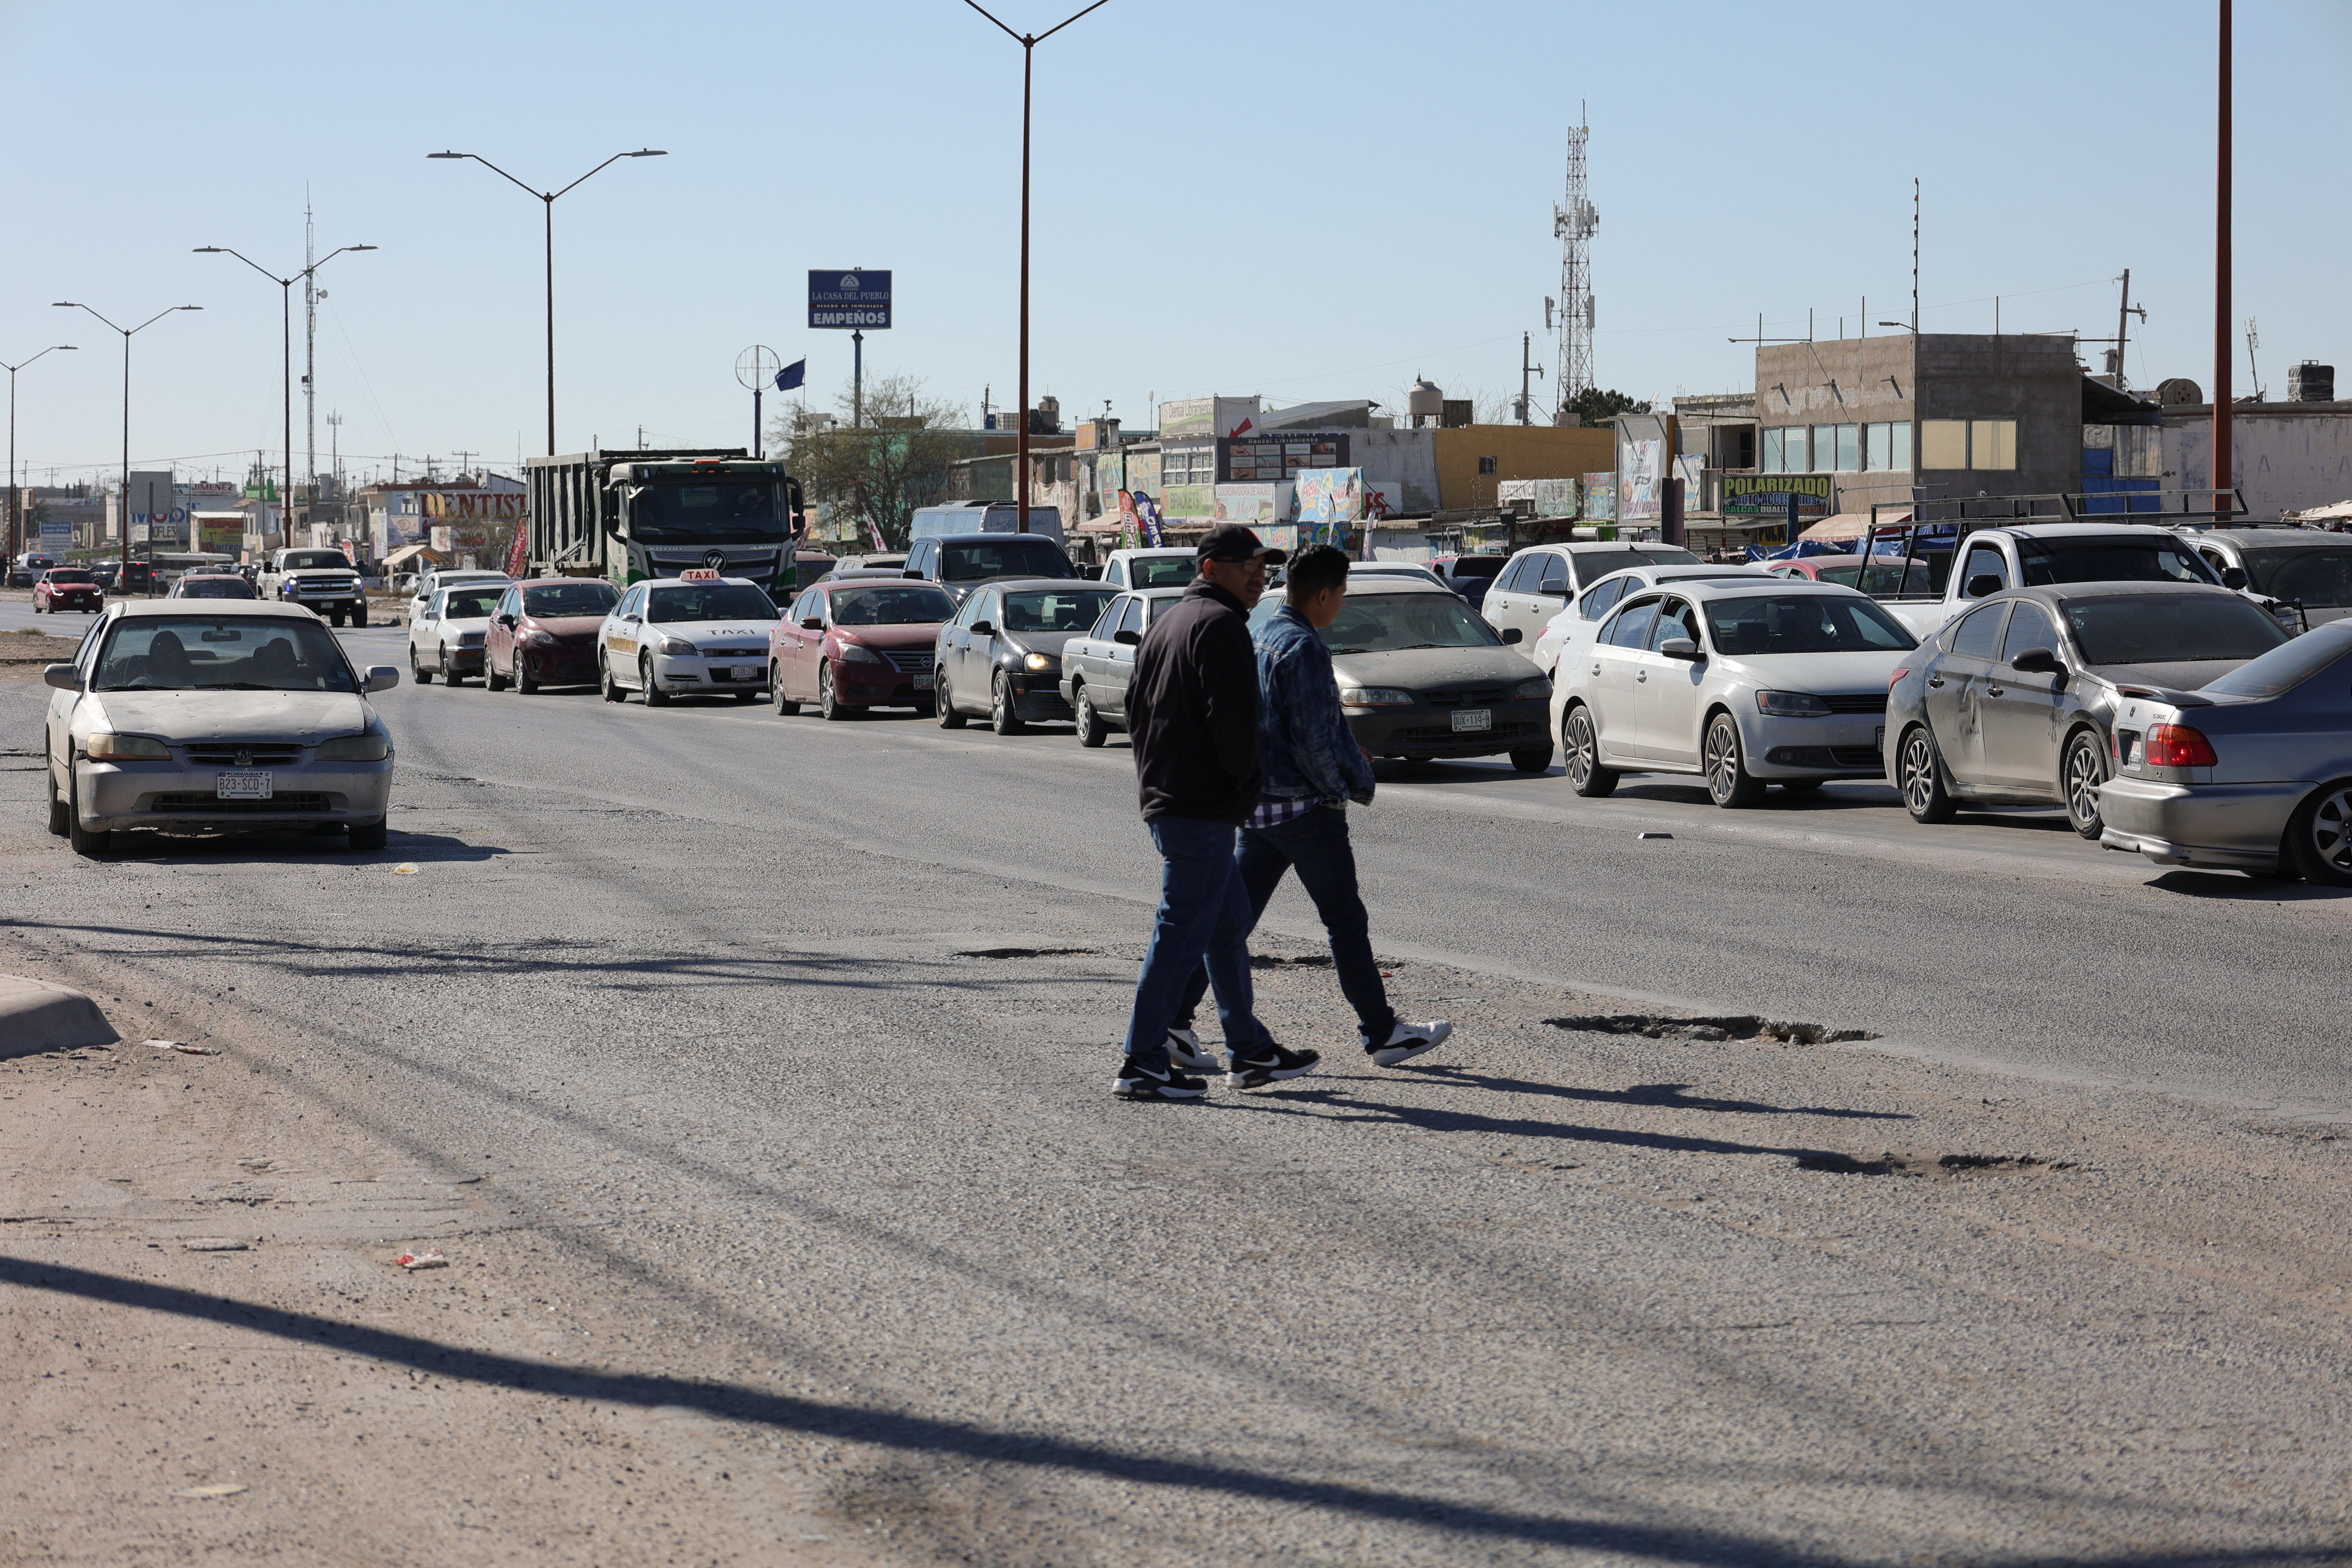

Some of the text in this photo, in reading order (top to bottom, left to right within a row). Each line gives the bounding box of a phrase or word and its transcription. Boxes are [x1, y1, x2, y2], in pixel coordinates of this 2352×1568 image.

[812, 292, 822, 300] LA
[823, 292, 842, 300] CASA
[861, 291, 889, 300] PUEBLO
[814, 309, 886, 325] EMPEÑOS
[1169, 401, 1213, 418] Dental Libramiento
[1219, 486, 1271, 496] COORDINADORA DE VIAJES
[1724, 477, 1828, 498] POLARIZADO
[1170, 492, 1200, 510] BRACKETS
[1736, 493, 1818, 505] AUTO-ACCESRIOS
[152, 526, 176, 538] OFLES
[686, 570, 715, 580] TAXI
[1454, 714, 1490, 726] DUX-114-B
[220, 778, 270, 790] B23-SCD-7
